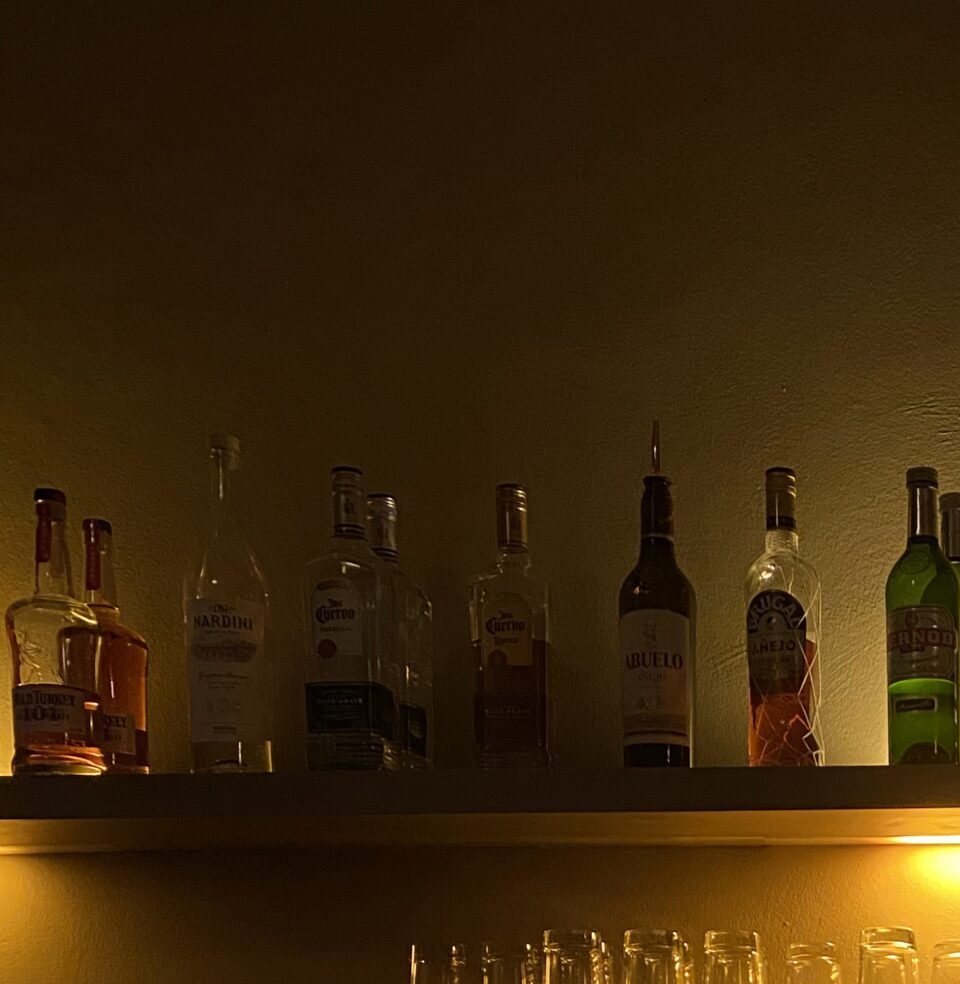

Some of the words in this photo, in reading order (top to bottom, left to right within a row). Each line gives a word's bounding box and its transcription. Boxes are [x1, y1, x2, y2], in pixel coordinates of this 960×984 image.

[193, 614, 253, 631] NARDINI
[315, 605, 355, 624] Cuervo
[486, 616, 526, 636] Cuervo
[889, 630, 954, 648] ERNOD
[625, 651, 684, 670] ABUELO
